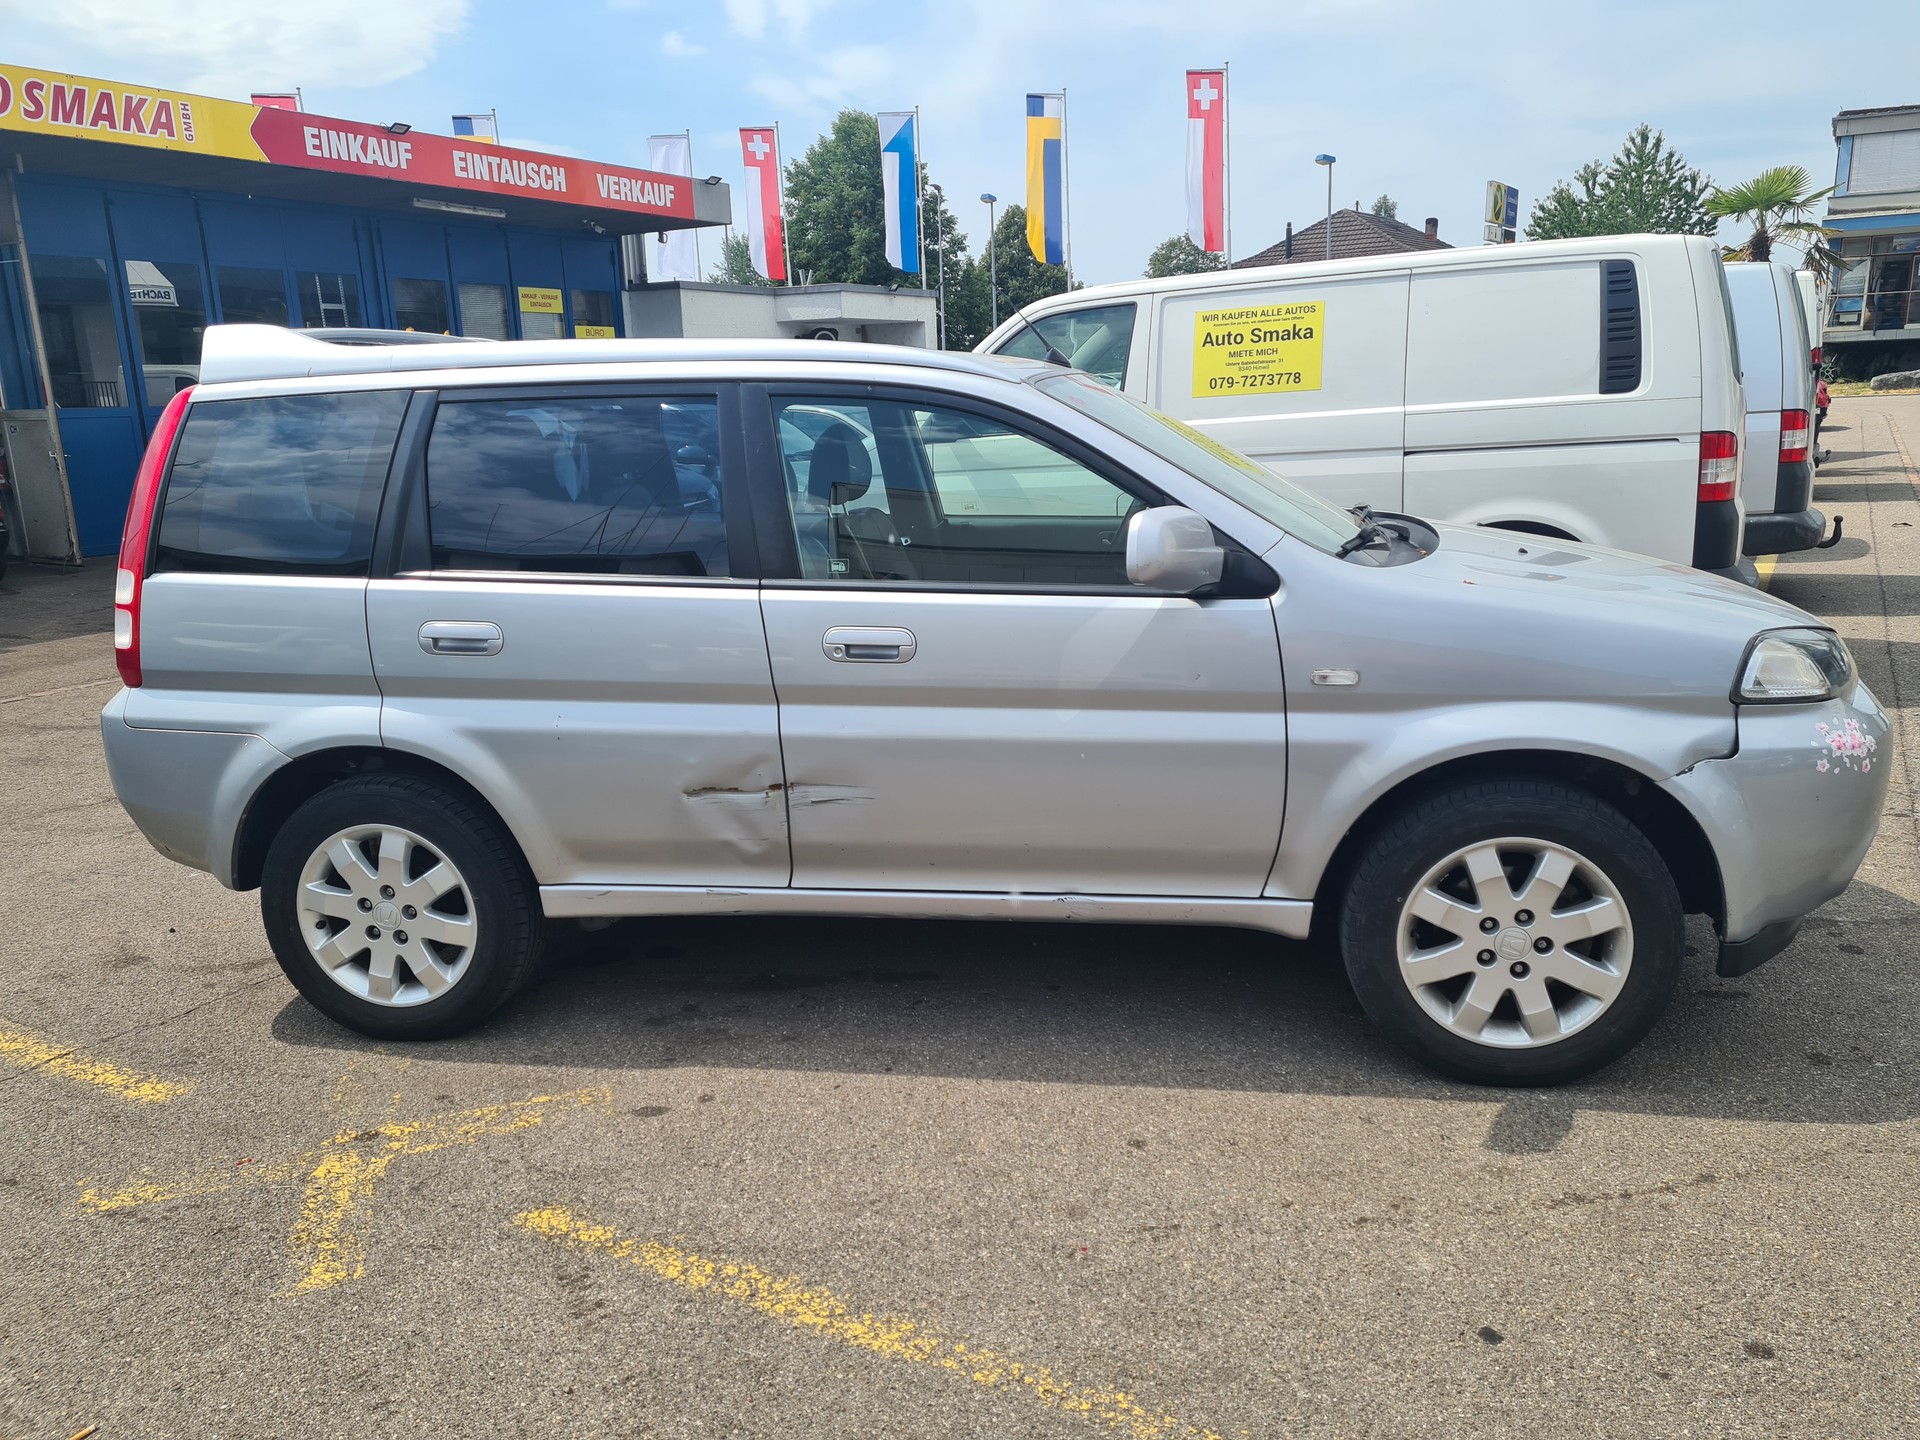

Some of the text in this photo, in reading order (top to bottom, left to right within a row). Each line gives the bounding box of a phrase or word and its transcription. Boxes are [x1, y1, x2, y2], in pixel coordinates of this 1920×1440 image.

[21, 79, 177, 140] SMAKA
[180, 102, 195, 142] GMBH
[303, 126, 412, 170] EINKAUF
[452, 150, 567, 193] EINTAUSCH
[596, 173, 675, 208] VERKAUF
[1202, 305, 1317, 322] WIR KAUFEN ALLE AUTOS
[585, 327, 604, 337] BÜRO
[1202, 324, 1314, 347] Auto Smaka
[1228, 347, 1278, 358] MIETE MICH
[1209, 372, 1302, 389] 079-7273778
